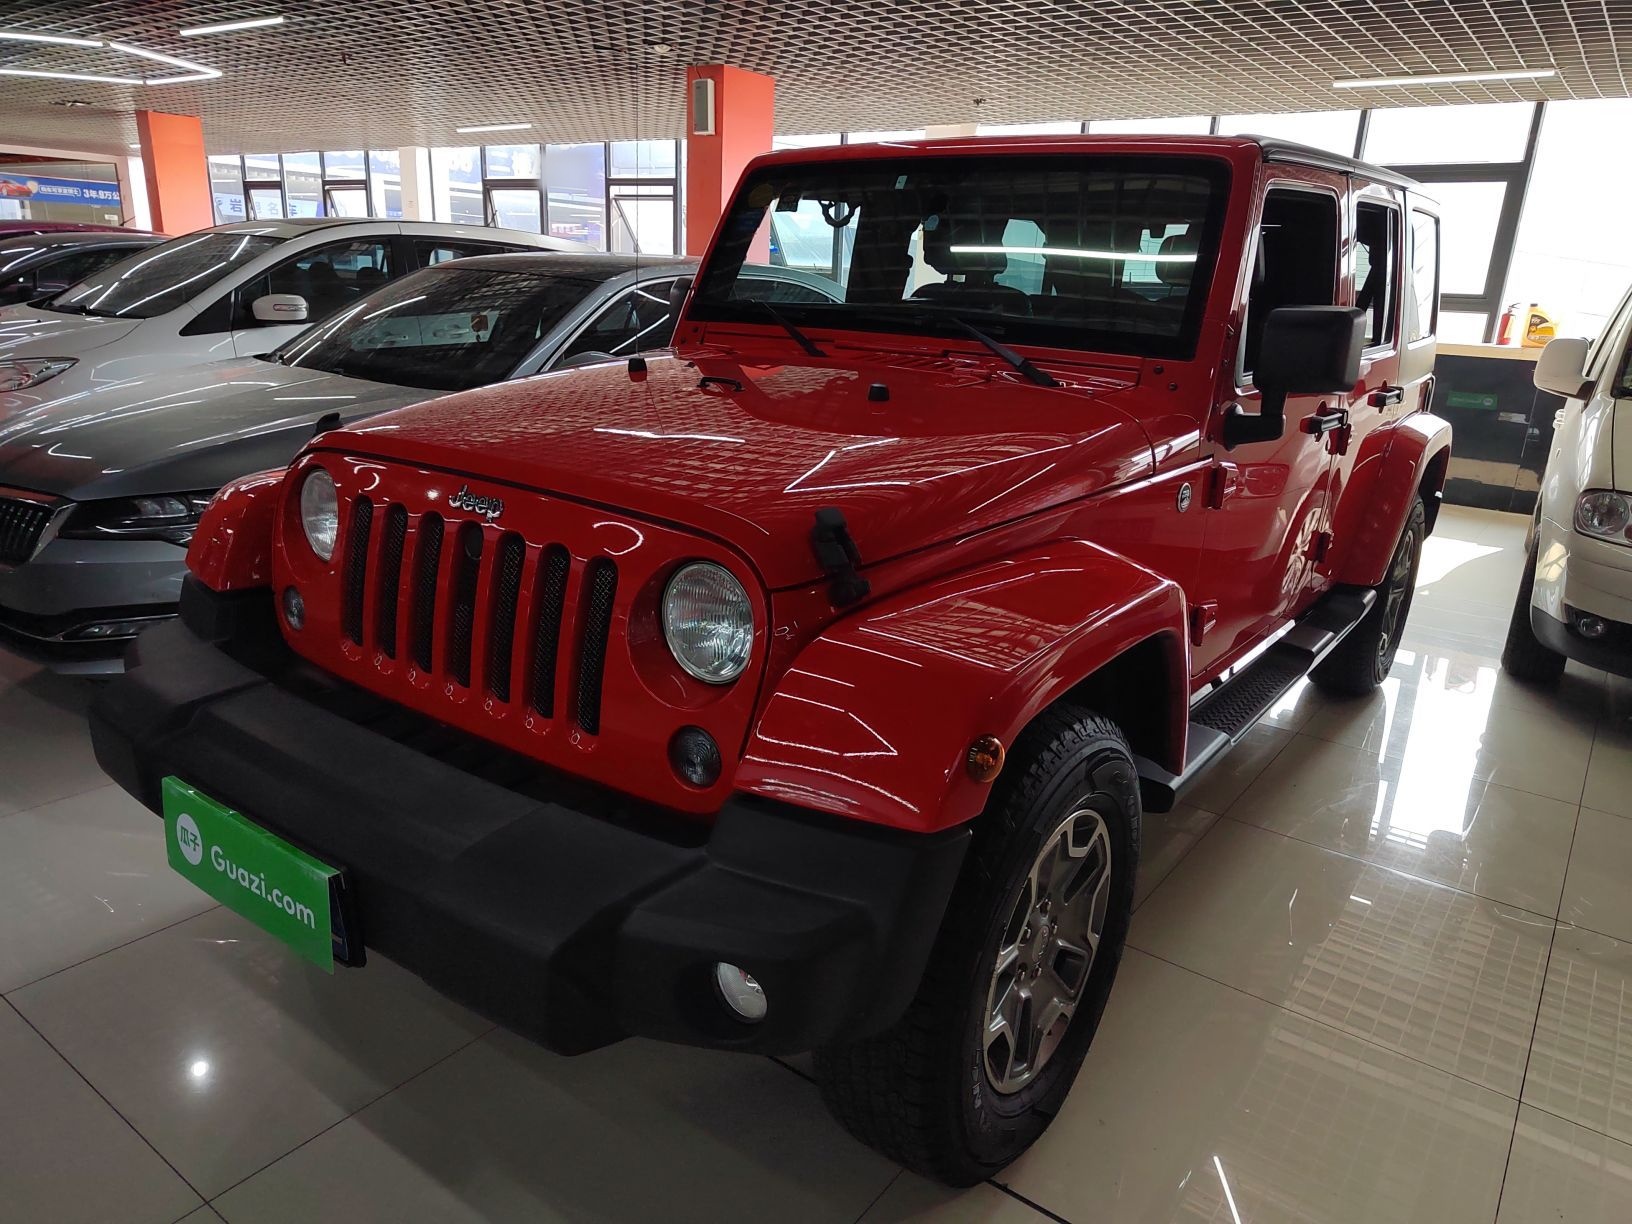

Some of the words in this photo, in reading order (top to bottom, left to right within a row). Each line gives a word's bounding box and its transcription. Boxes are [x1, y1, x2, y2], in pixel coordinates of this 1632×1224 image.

[448, 484, 504, 523] Jeep
[180, 826, 200, 852] 瓜子
[210, 845, 316, 929] Guazi.com
